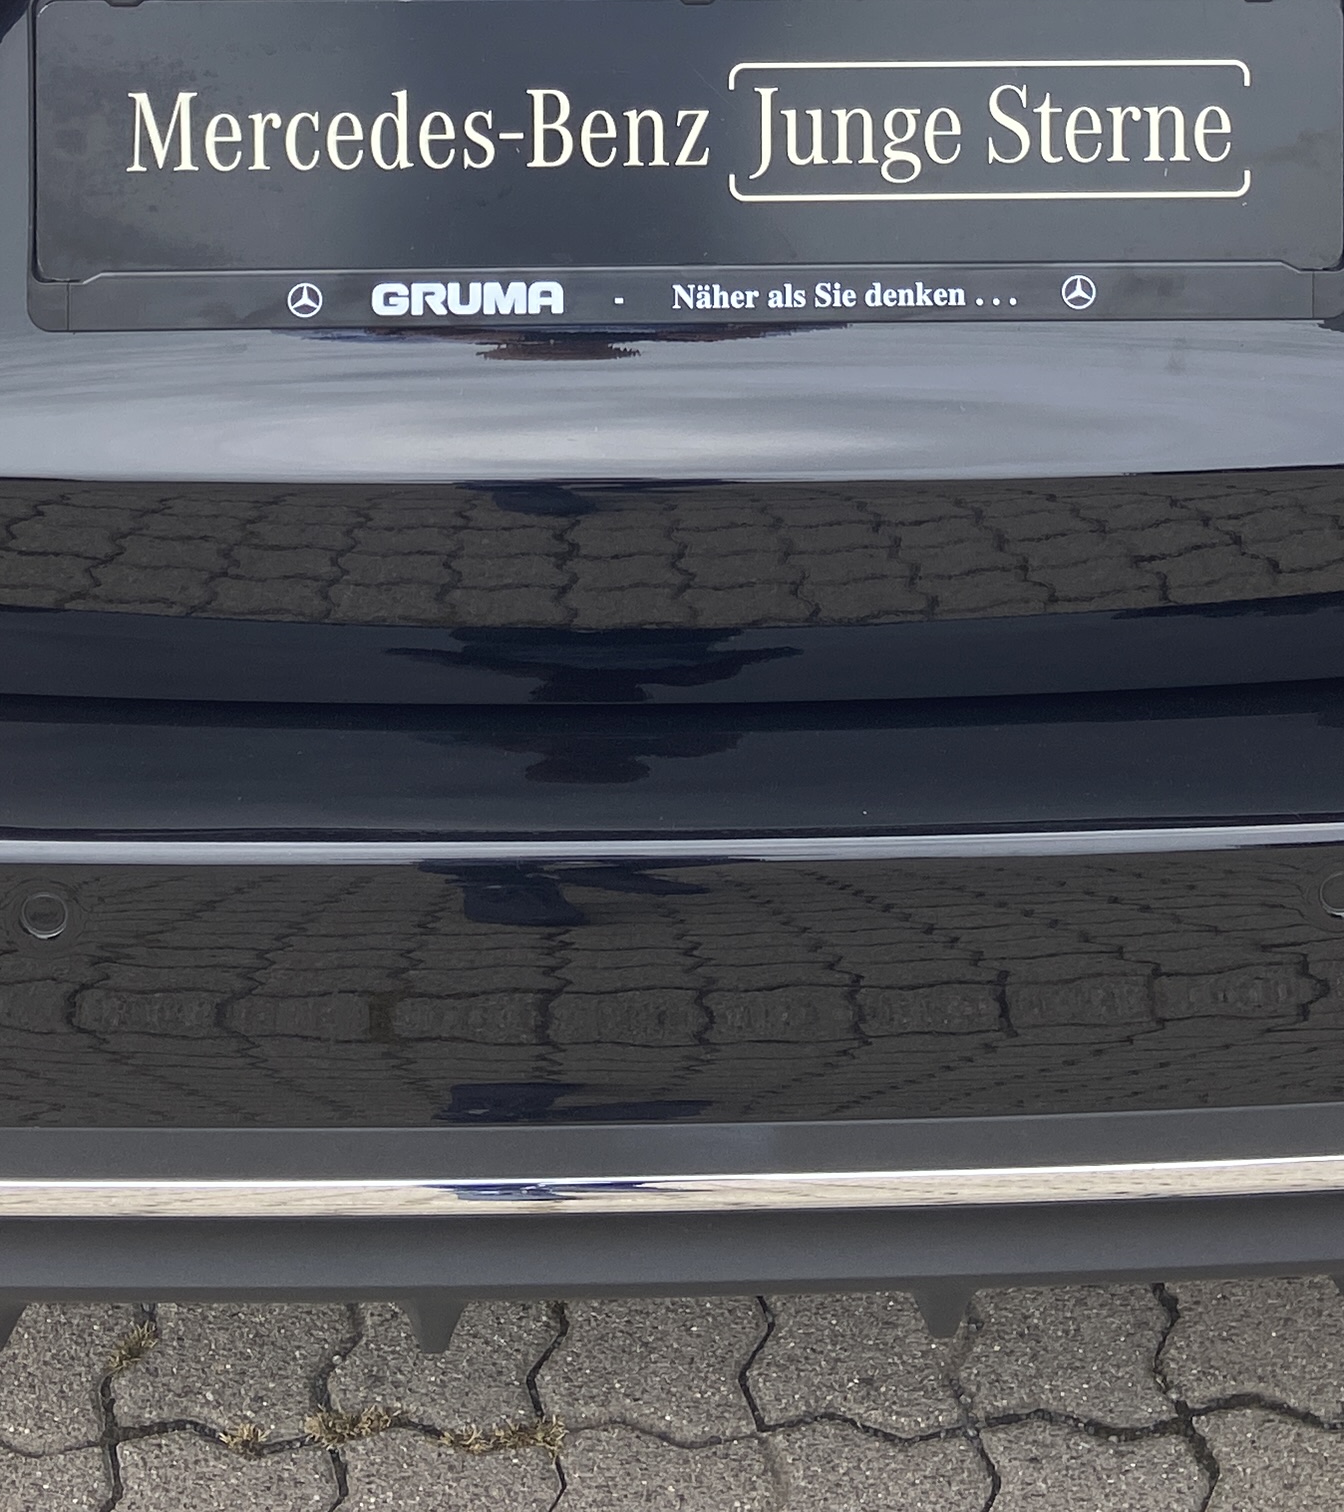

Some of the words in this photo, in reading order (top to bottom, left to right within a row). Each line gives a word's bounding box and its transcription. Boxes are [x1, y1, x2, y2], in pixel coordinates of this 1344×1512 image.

[126, 89, 710, 173] Mercedes-Benz
[748, 86, 962, 184] Junge
[987, 83, 1233, 165] Sterne
[371, 281, 565, 317] GRUMA
[671, 283, 760, 310] Näher
[767, 282, 807, 309] als
[814, 281, 857, 308] Sie
